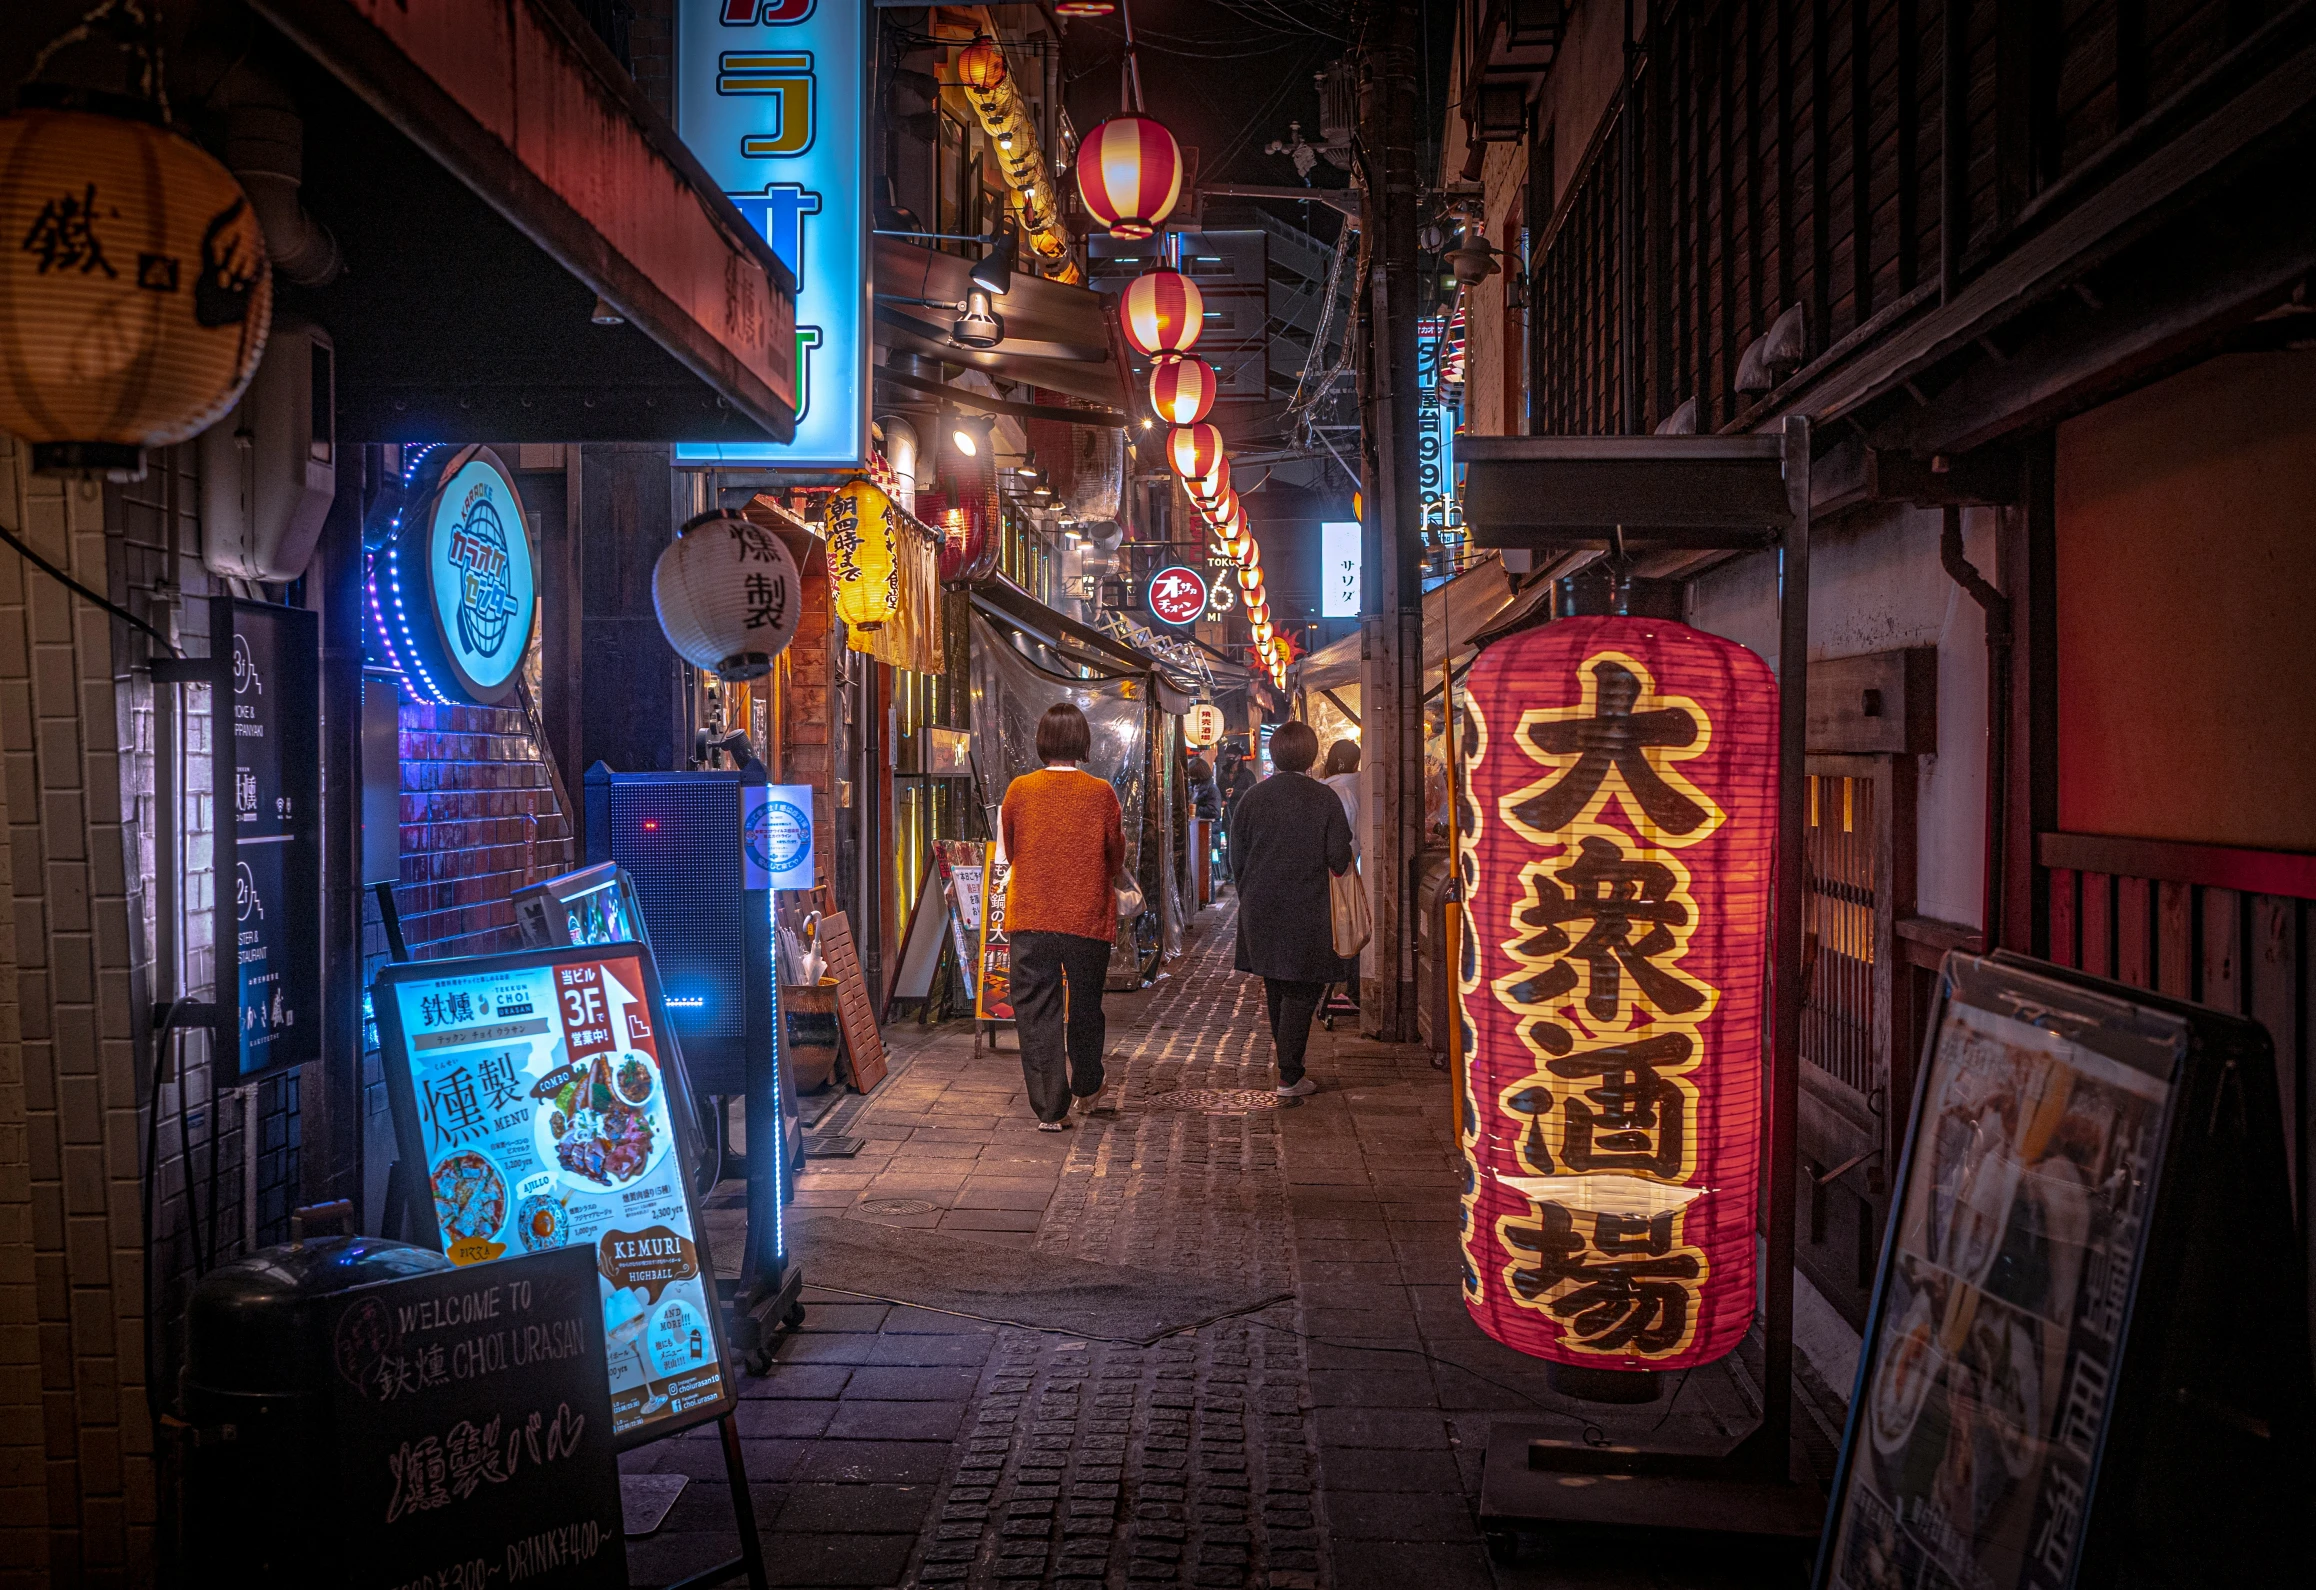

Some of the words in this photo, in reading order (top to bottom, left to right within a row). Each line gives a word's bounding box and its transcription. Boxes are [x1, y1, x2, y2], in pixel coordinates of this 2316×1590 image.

[460, 483, 494, 522] KARAOKE
[830, 495, 866, 582] 朝四時まで
[449, 526, 508, 581] カラオケ
[730, 524, 787, 630] 燻製
[464, 572, 518, 616] センター
[1209, 568, 1234, 611] 6
[1207, 612, 1221, 622] MI
[233, 650, 246, 677] 3f
[234, 705, 249, 719] OKE
[250, 706, 256, 719] &
[234, 724, 264, 738] PPANYAKI
[236, 878, 249, 905] 2f
[237, 931, 254, 946] STER
[254, 931, 259, 943] &
[237, 946, 267, 965] STAURANT
[561, 968, 596, 986] 当ビル
[494, 984, 528, 994] TEKKUN
[496, 992, 530, 1005] CHOI
[420, 991, 475, 1027] 鉄燻
[498, 1004, 532, 1017] URASAN
[563, 987, 605, 1026] 3Fで
[1492, 652, 1727, 1359] 大衆酒場
[437, 1033, 467, 1045] テックン
[471, 1029, 492, 1040] チョイ
[496, 1025, 526, 1037] ウラサン
[434, 1058, 459, 1071] くんせい
[538, 1071, 571, 1092] COMBO
[422, 1052, 525, 1155] 燻製
[494, 1108, 530, 1132] MENU
[523, 1175, 550, 1194] AJILLO
[459, 1246, 491, 1260] PIZZA
[614, 1236, 682, 1259] KEMURI
[628, 1269, 674, 1282] HIGHBALL
[397, 1286, 501, 1334] WELCOME
[509, 1280, 532, 1311] TO
[663, 1307, 682, 1320] AND
[372, 1343, 450, 1402] 鉄燻
[452, 1328, 507, 1381] CHOI
[512, 1317, 586, 1370] URASAN
